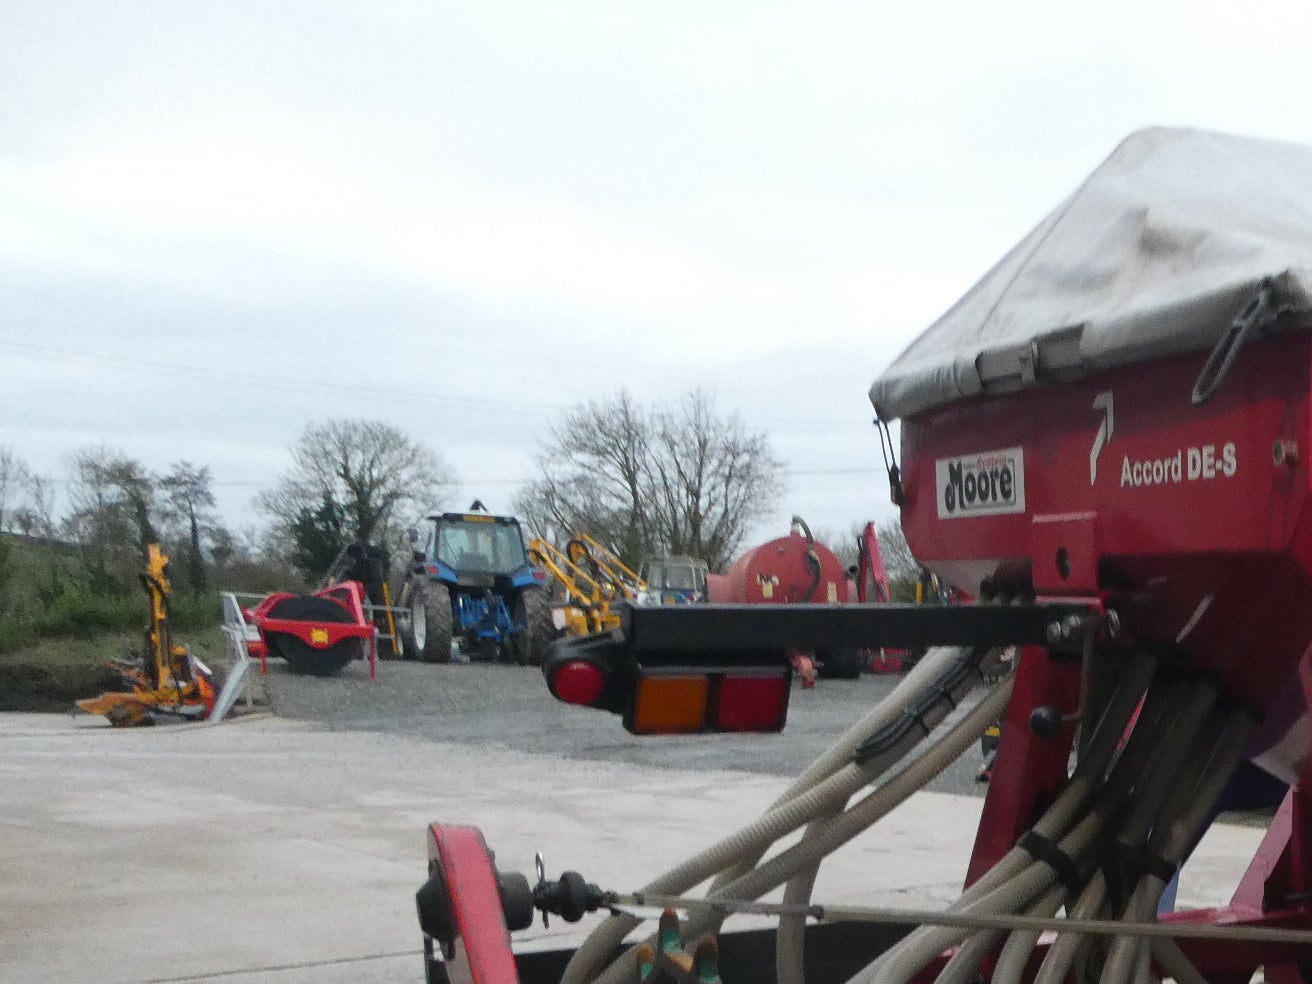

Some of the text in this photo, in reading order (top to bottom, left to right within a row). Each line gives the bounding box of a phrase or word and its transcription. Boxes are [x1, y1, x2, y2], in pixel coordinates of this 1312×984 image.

[944, 460, 1013, 513] Moore
[1120, 442, 1237, 488] Accord DE-S
